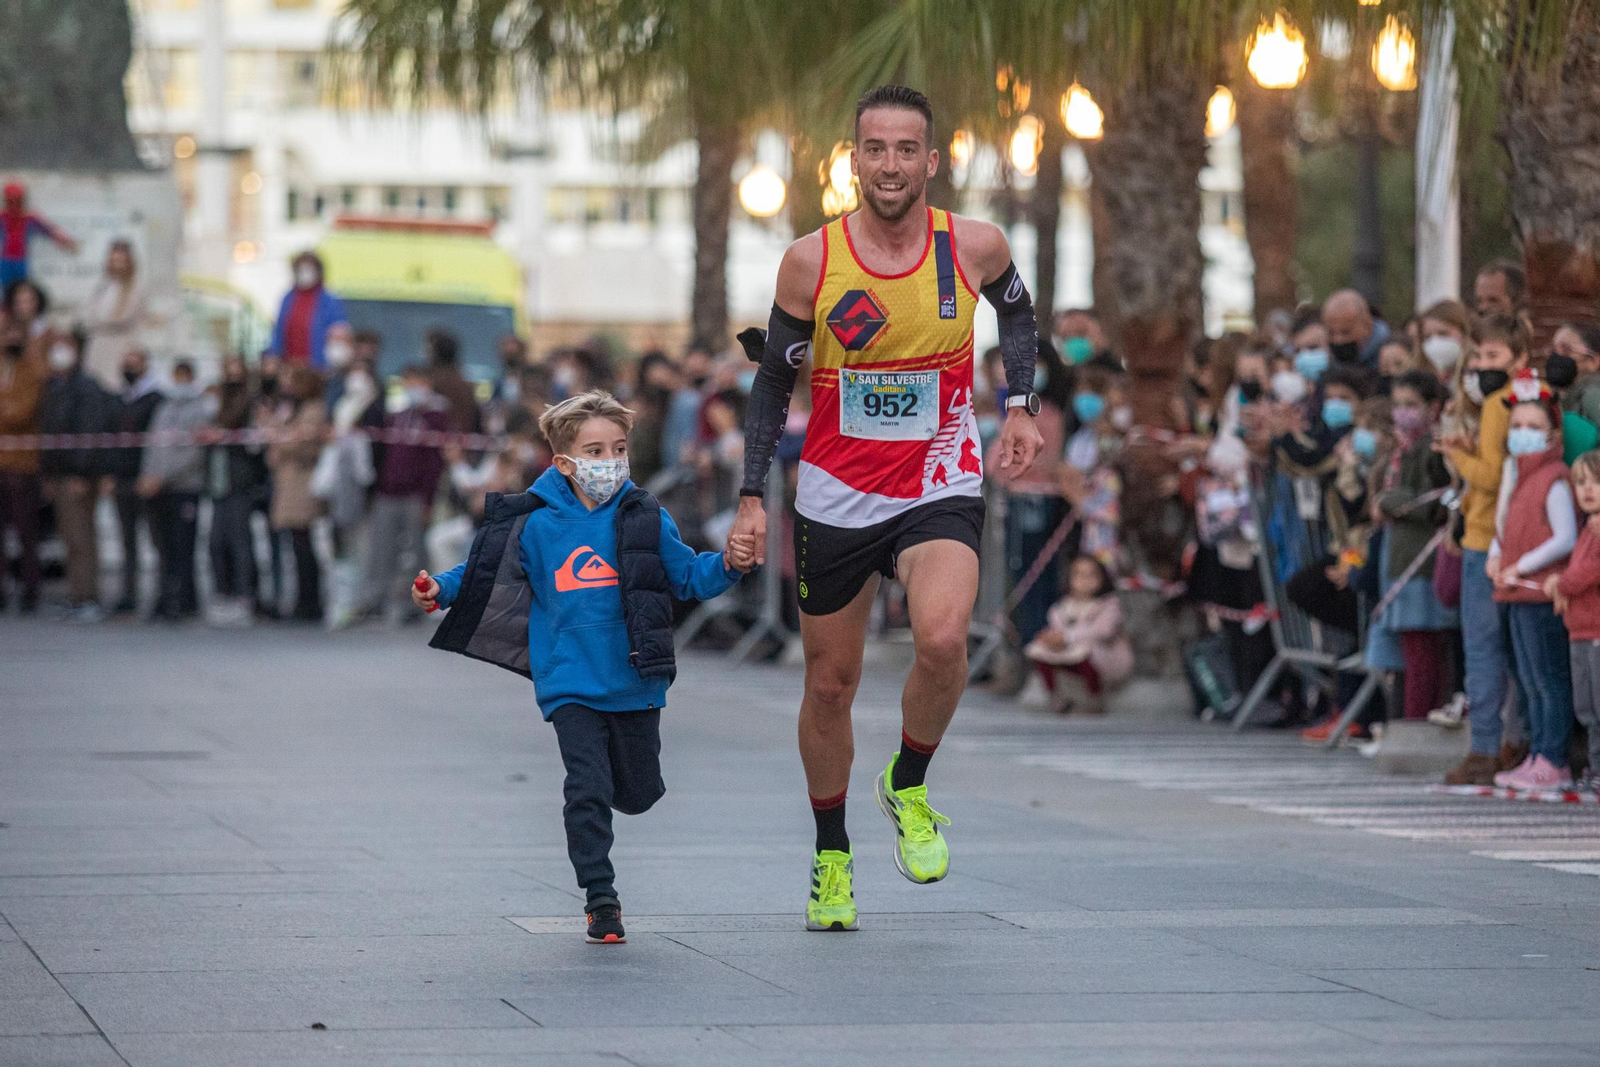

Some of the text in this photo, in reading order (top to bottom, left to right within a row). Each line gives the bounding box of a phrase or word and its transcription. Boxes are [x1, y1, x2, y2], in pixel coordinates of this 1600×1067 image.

[849, 373, 933, 385] V SAN SILVESTRE
[872, 385, 907, 393] Gaditana
[863, 392, 918, 418] 952
